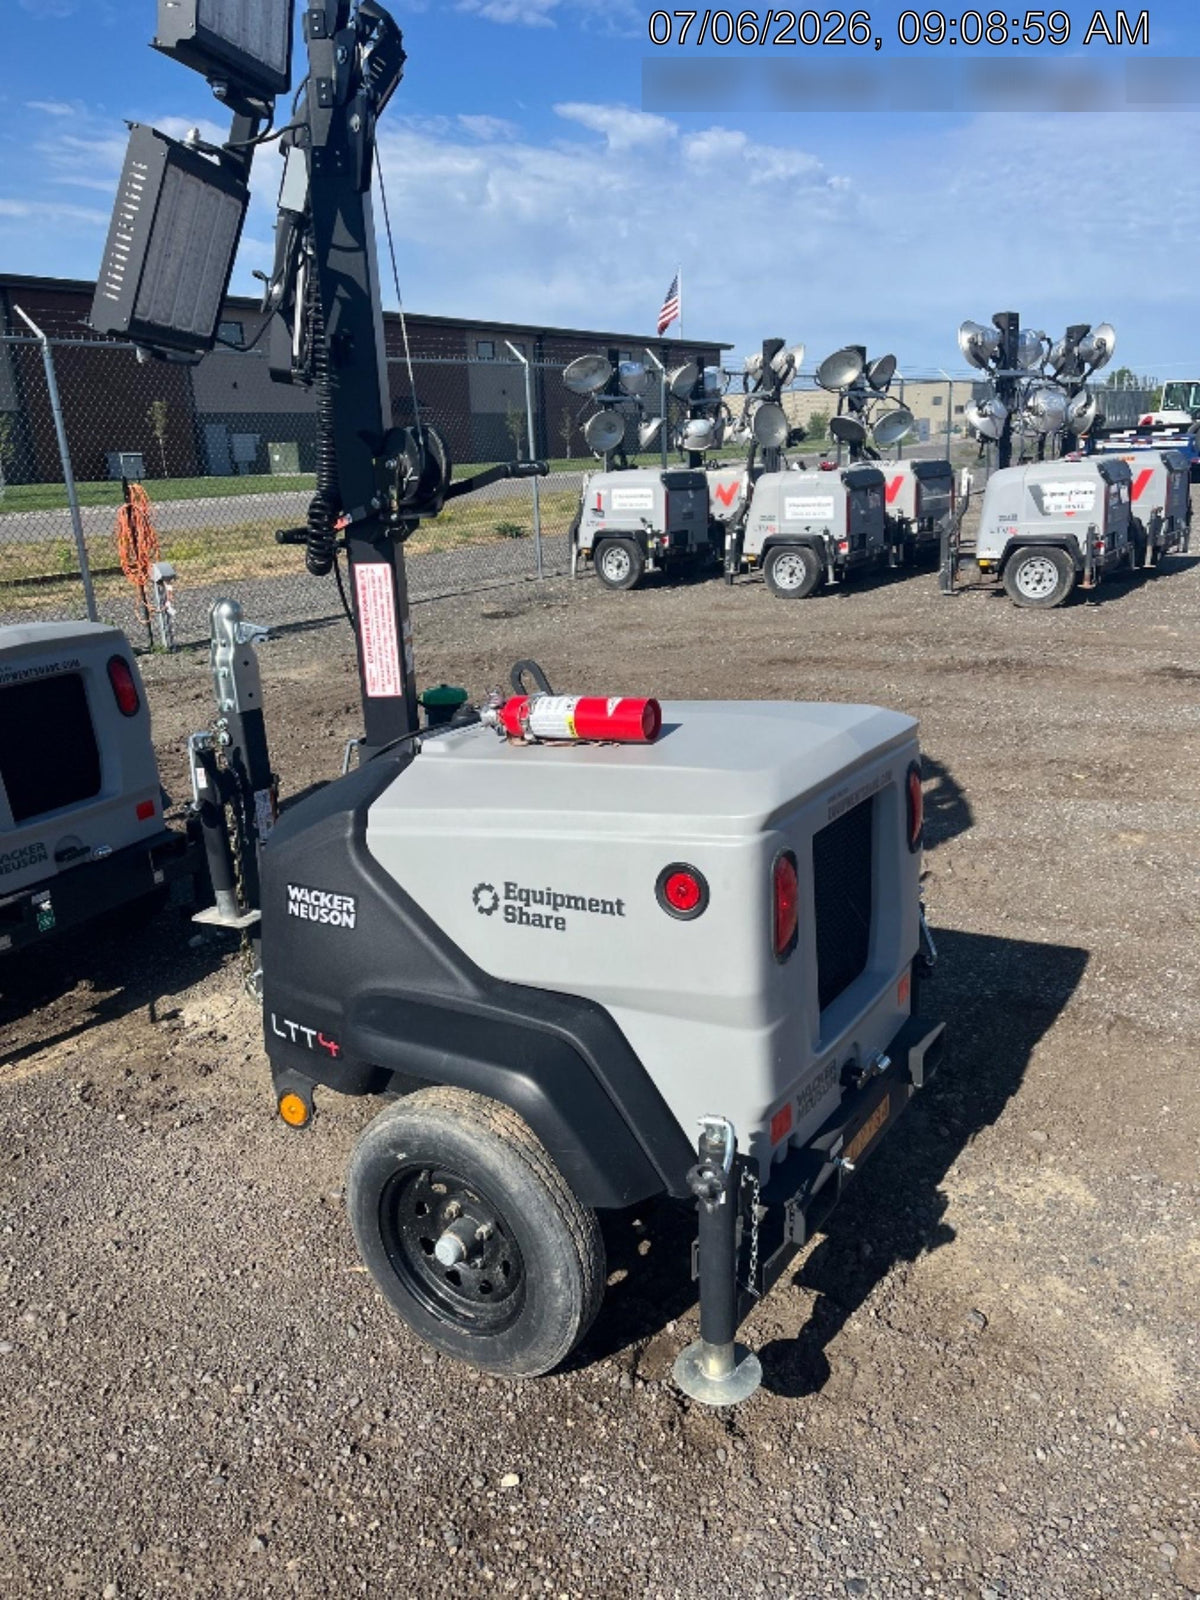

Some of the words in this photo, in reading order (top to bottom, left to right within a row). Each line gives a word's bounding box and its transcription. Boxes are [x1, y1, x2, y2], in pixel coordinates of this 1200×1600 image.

[0, 842, 45, 864] ACKER
[287, 884, 356, 913] WACKER
[503, 881, 626, 917] Equipment
[287, 901, 356, 929] NEUSON
[503, 909, 567, 931] Share
[270, 1012, 340, 1058] LTT4
